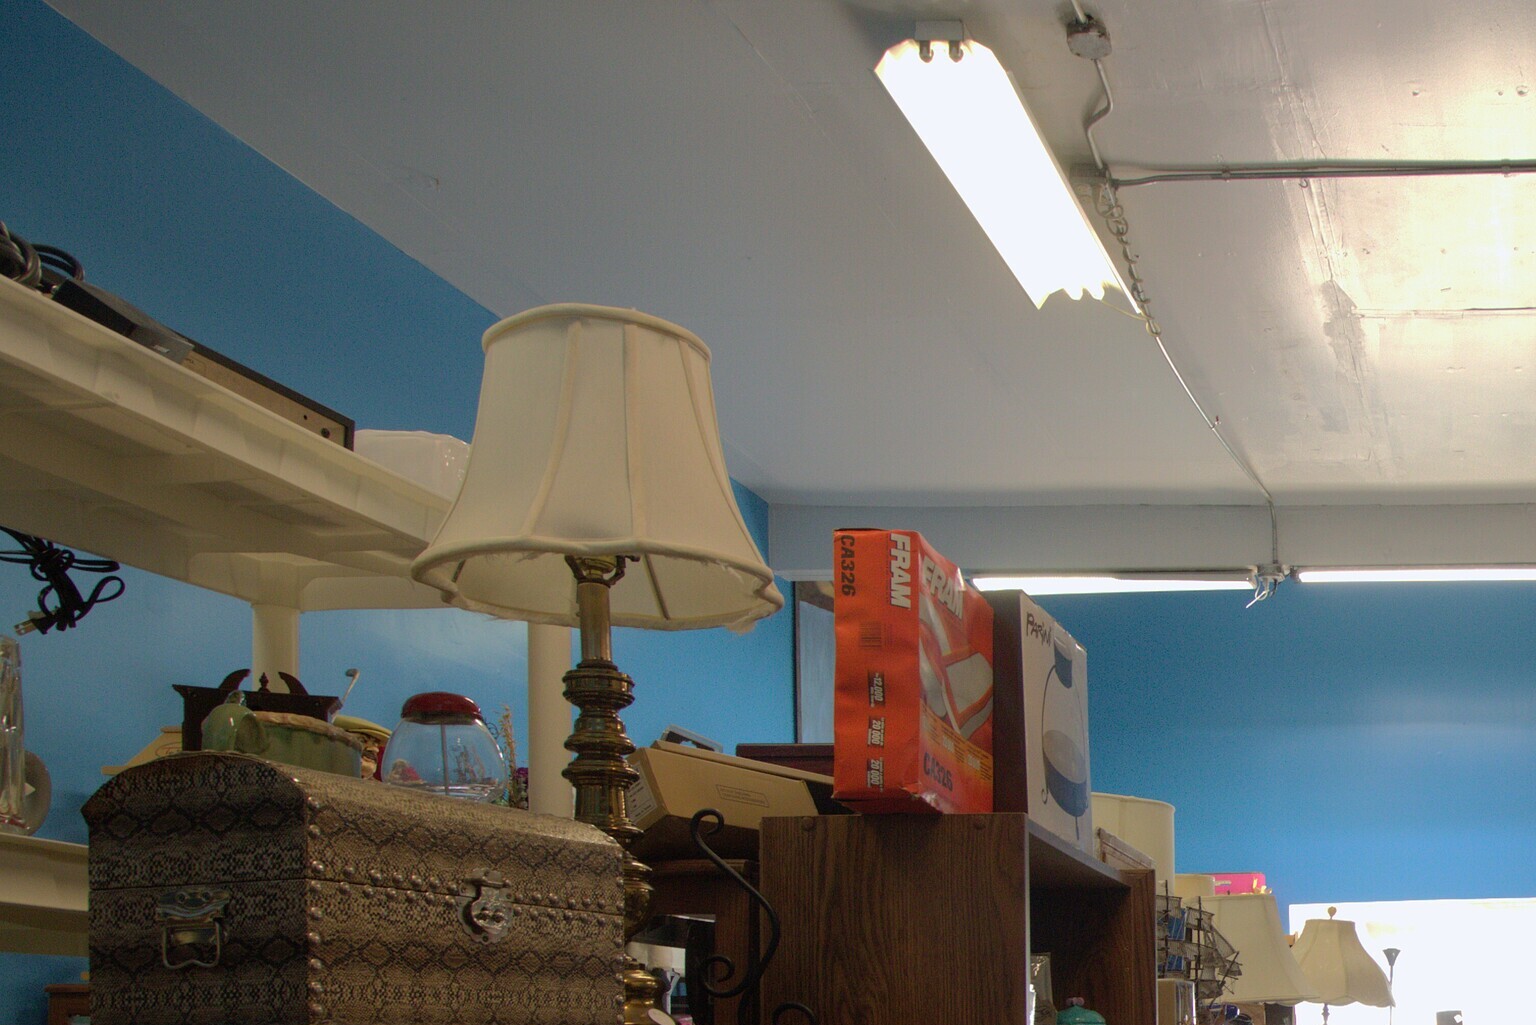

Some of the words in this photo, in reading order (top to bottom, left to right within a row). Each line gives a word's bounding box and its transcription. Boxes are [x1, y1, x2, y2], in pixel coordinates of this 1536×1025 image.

[840, 535, 856, 597] CA326
[890, 533, 912, 611] FRAM
[922, 555, 964, 620] FRAM
[923, 752, 953, 791] CA326
